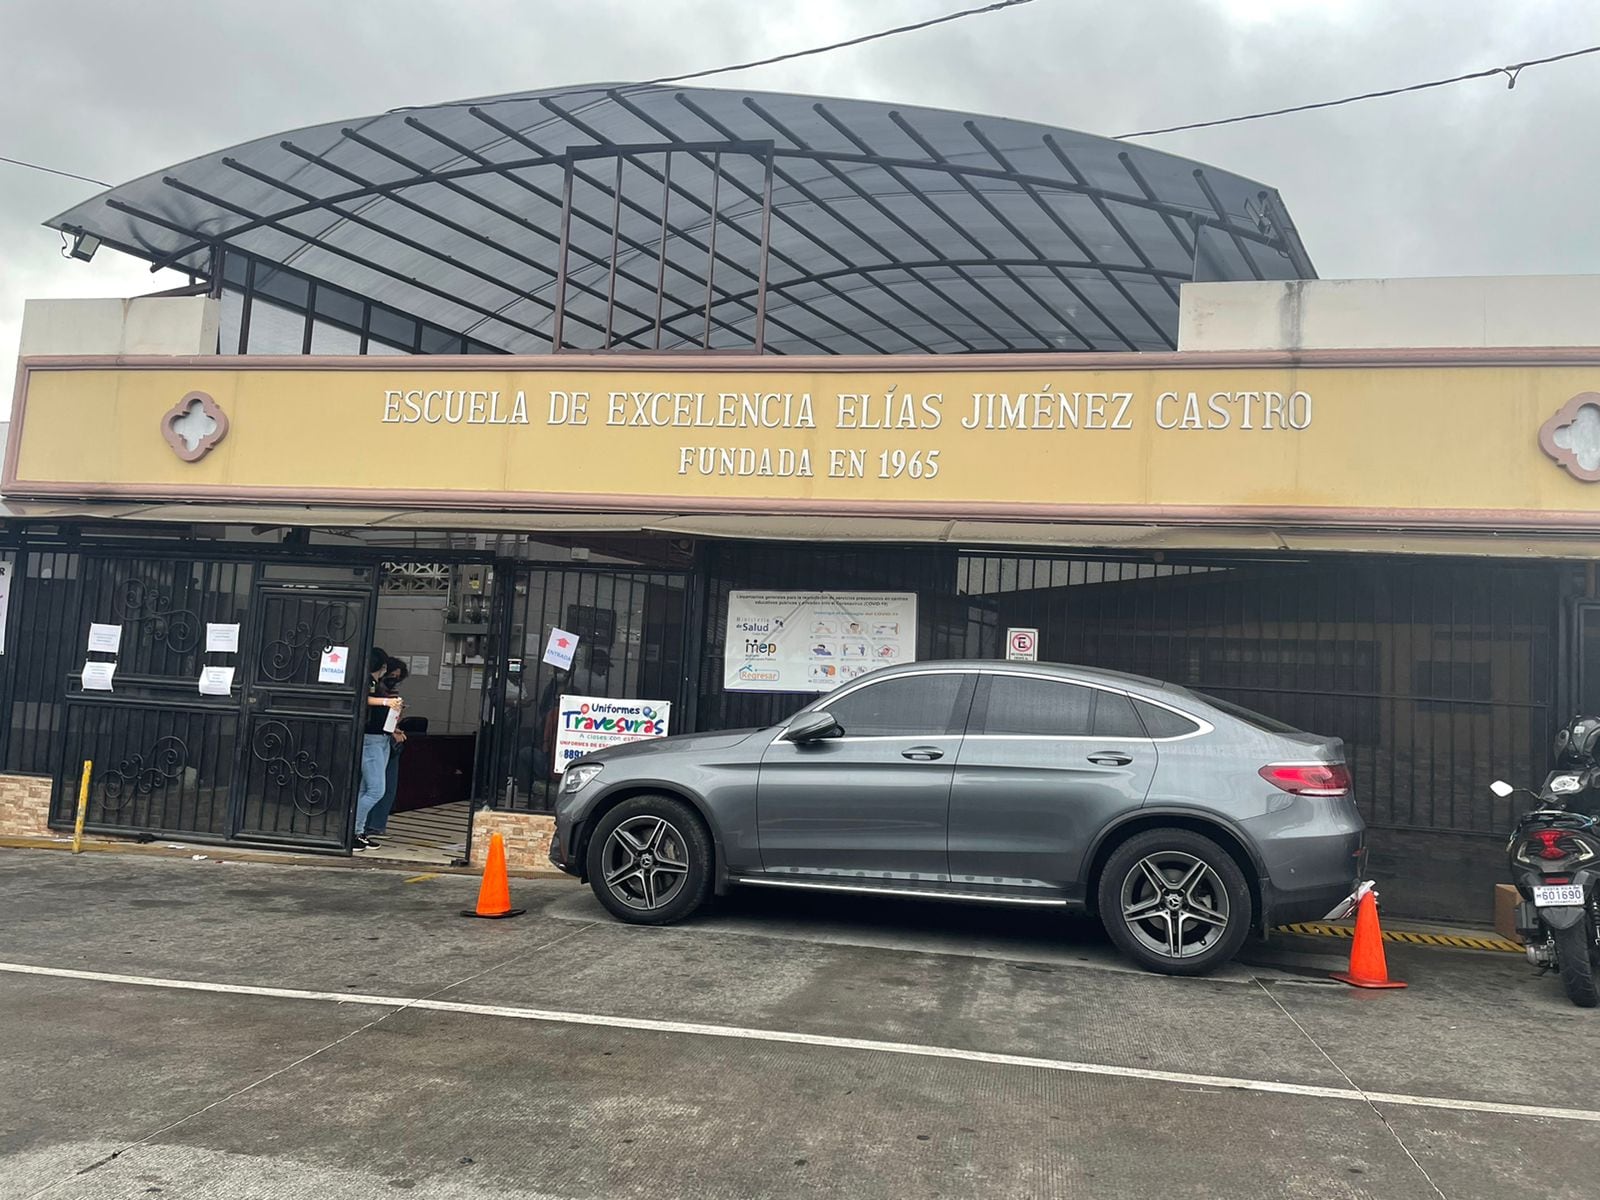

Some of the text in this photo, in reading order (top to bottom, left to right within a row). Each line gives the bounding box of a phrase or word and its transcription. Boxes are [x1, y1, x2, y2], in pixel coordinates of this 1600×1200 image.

[381, 384, 1313, 431] ESCUELA DE EXCELENCIA ELÍAS JIMÉNEZ CASTRO
[678, 446, 940, 480] FUNDADA EN 1965
[742, 622, 769, 632] Salud
[745, 638, 777, 656] mep
[546, 649, 571, 661] ENTRADA
[741, 671, 777, 679] Regresar
[591, 703, 641, 715] Uniformes
[562, 710, 664, 735] Travesuras
[1542, 890, 1582, 901] 601690
